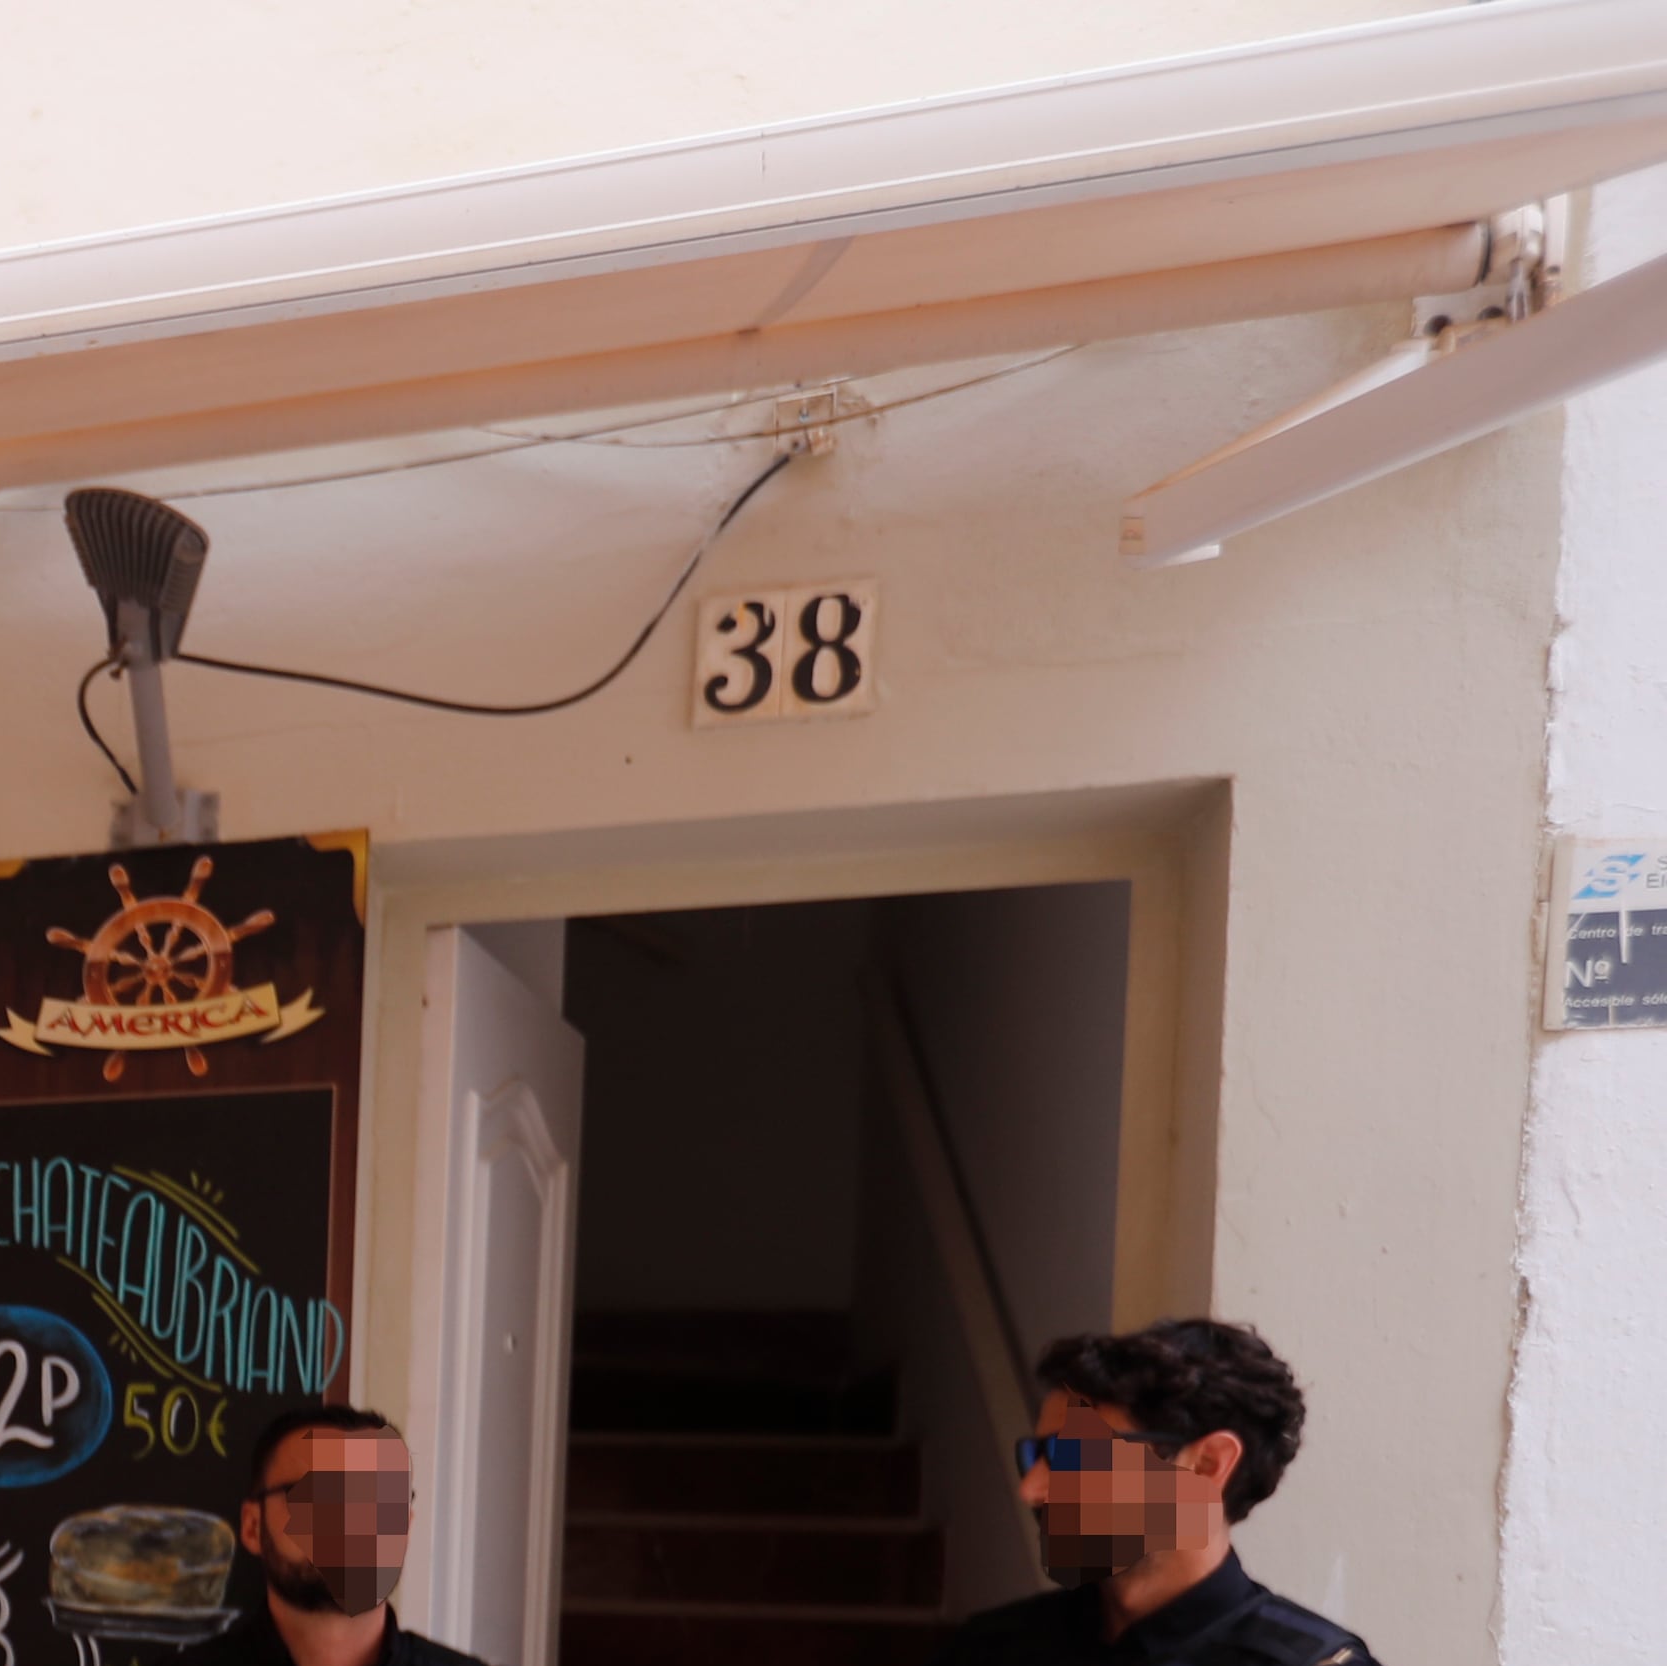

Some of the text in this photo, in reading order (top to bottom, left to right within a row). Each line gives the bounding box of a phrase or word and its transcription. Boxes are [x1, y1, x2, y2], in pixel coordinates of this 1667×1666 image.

[704, 594, 861, 713] 38
[1646, 872, 1667, 889] El
[1568, 927, 1616, 941] Centro
[1564, 959, 1610, 989] Nº
[48, 993, 268, 1039] AMERICA
